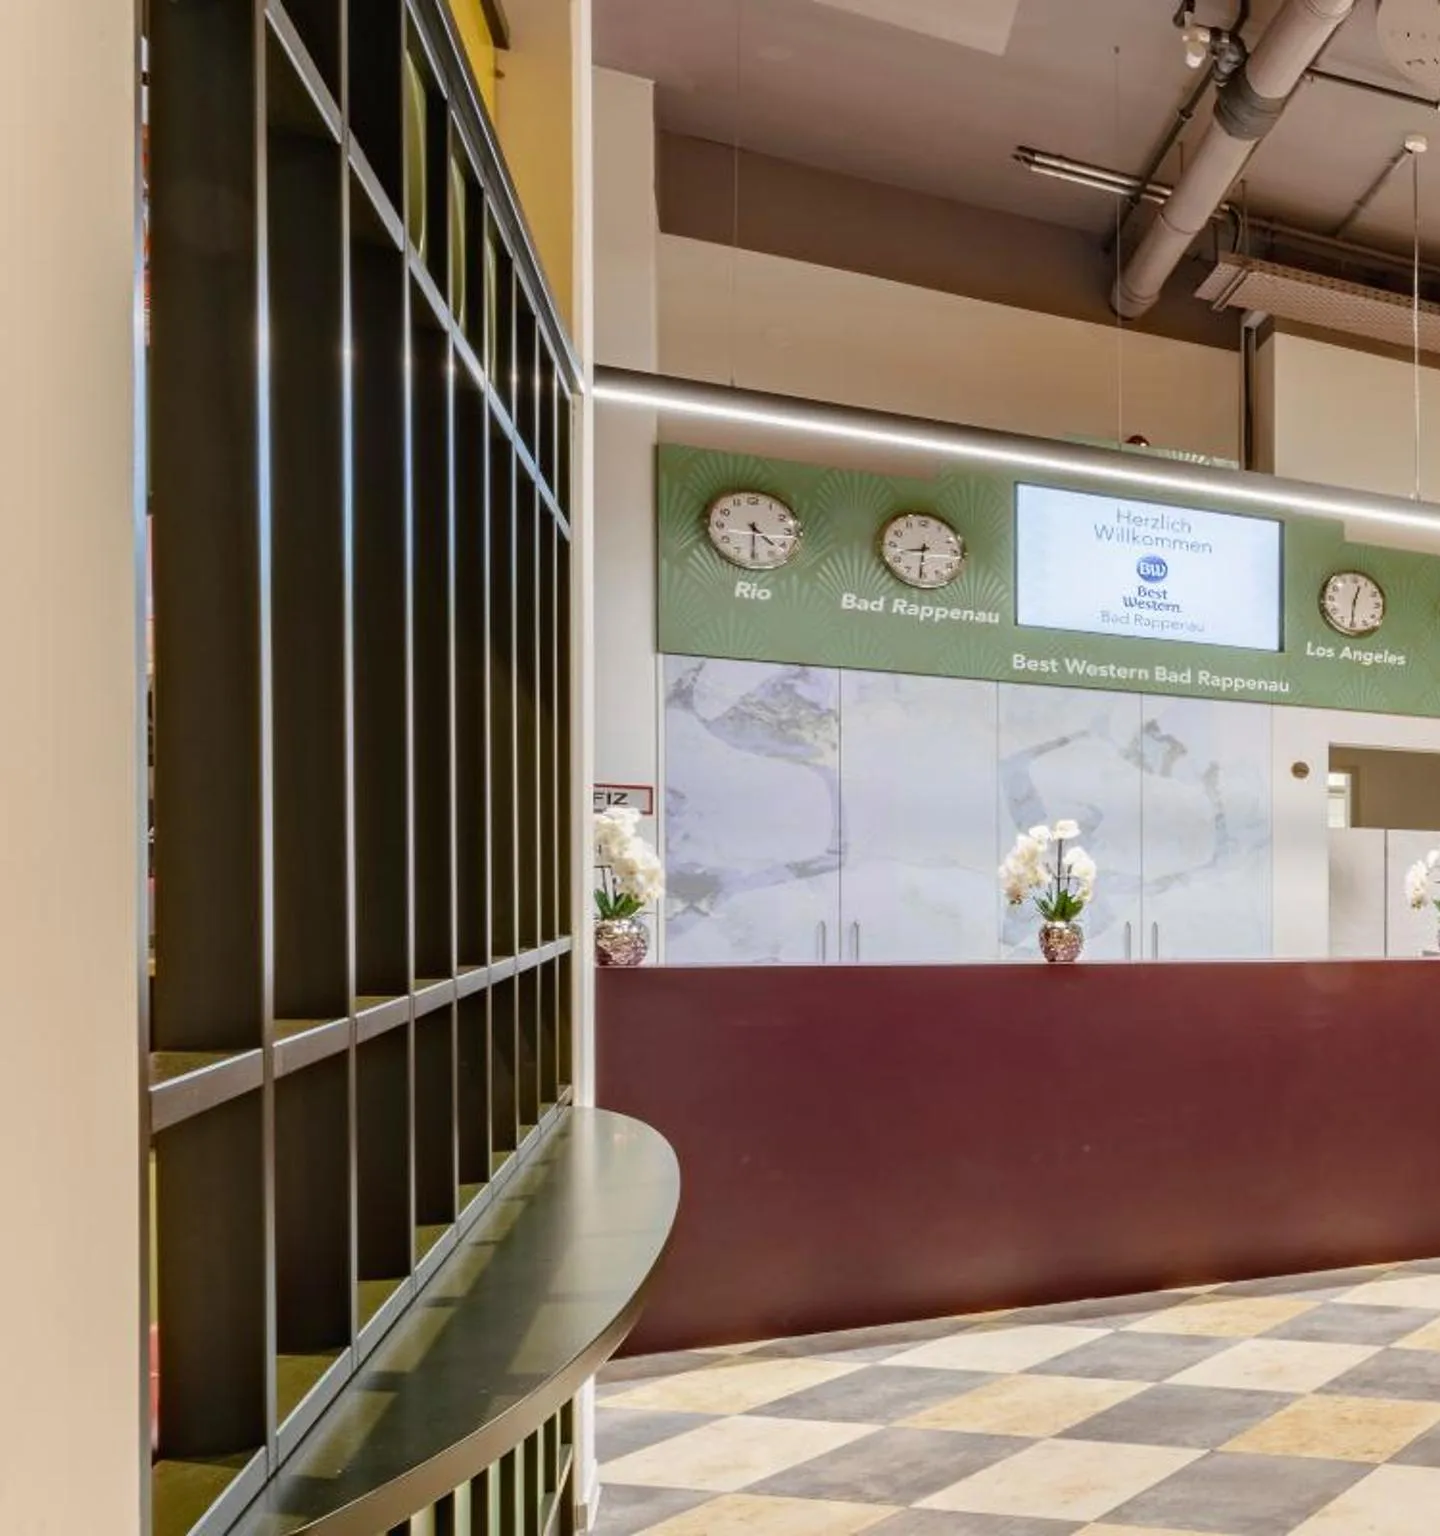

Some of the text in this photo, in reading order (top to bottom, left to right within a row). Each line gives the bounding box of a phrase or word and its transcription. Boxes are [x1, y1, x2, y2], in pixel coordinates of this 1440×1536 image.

[1116, 507, 1192, 534] Herzlich
[1094, 523, 1213, 554] Willkommen
[1139, 561, 1168, 578] BW
[734, 581, 772, 600] Rio
[1137, 585, 1168, 600] Best
[841, 593, 1000, 623] Bad Rappenau
[1122, 596, 1181, 613] Western
[1100, 610, 1205, 633] Bad Rappenau
[1306, 641, 1406, 666] Los Angeles
[1012, 653, 1290, 692] Best Western Bad Rappenau
